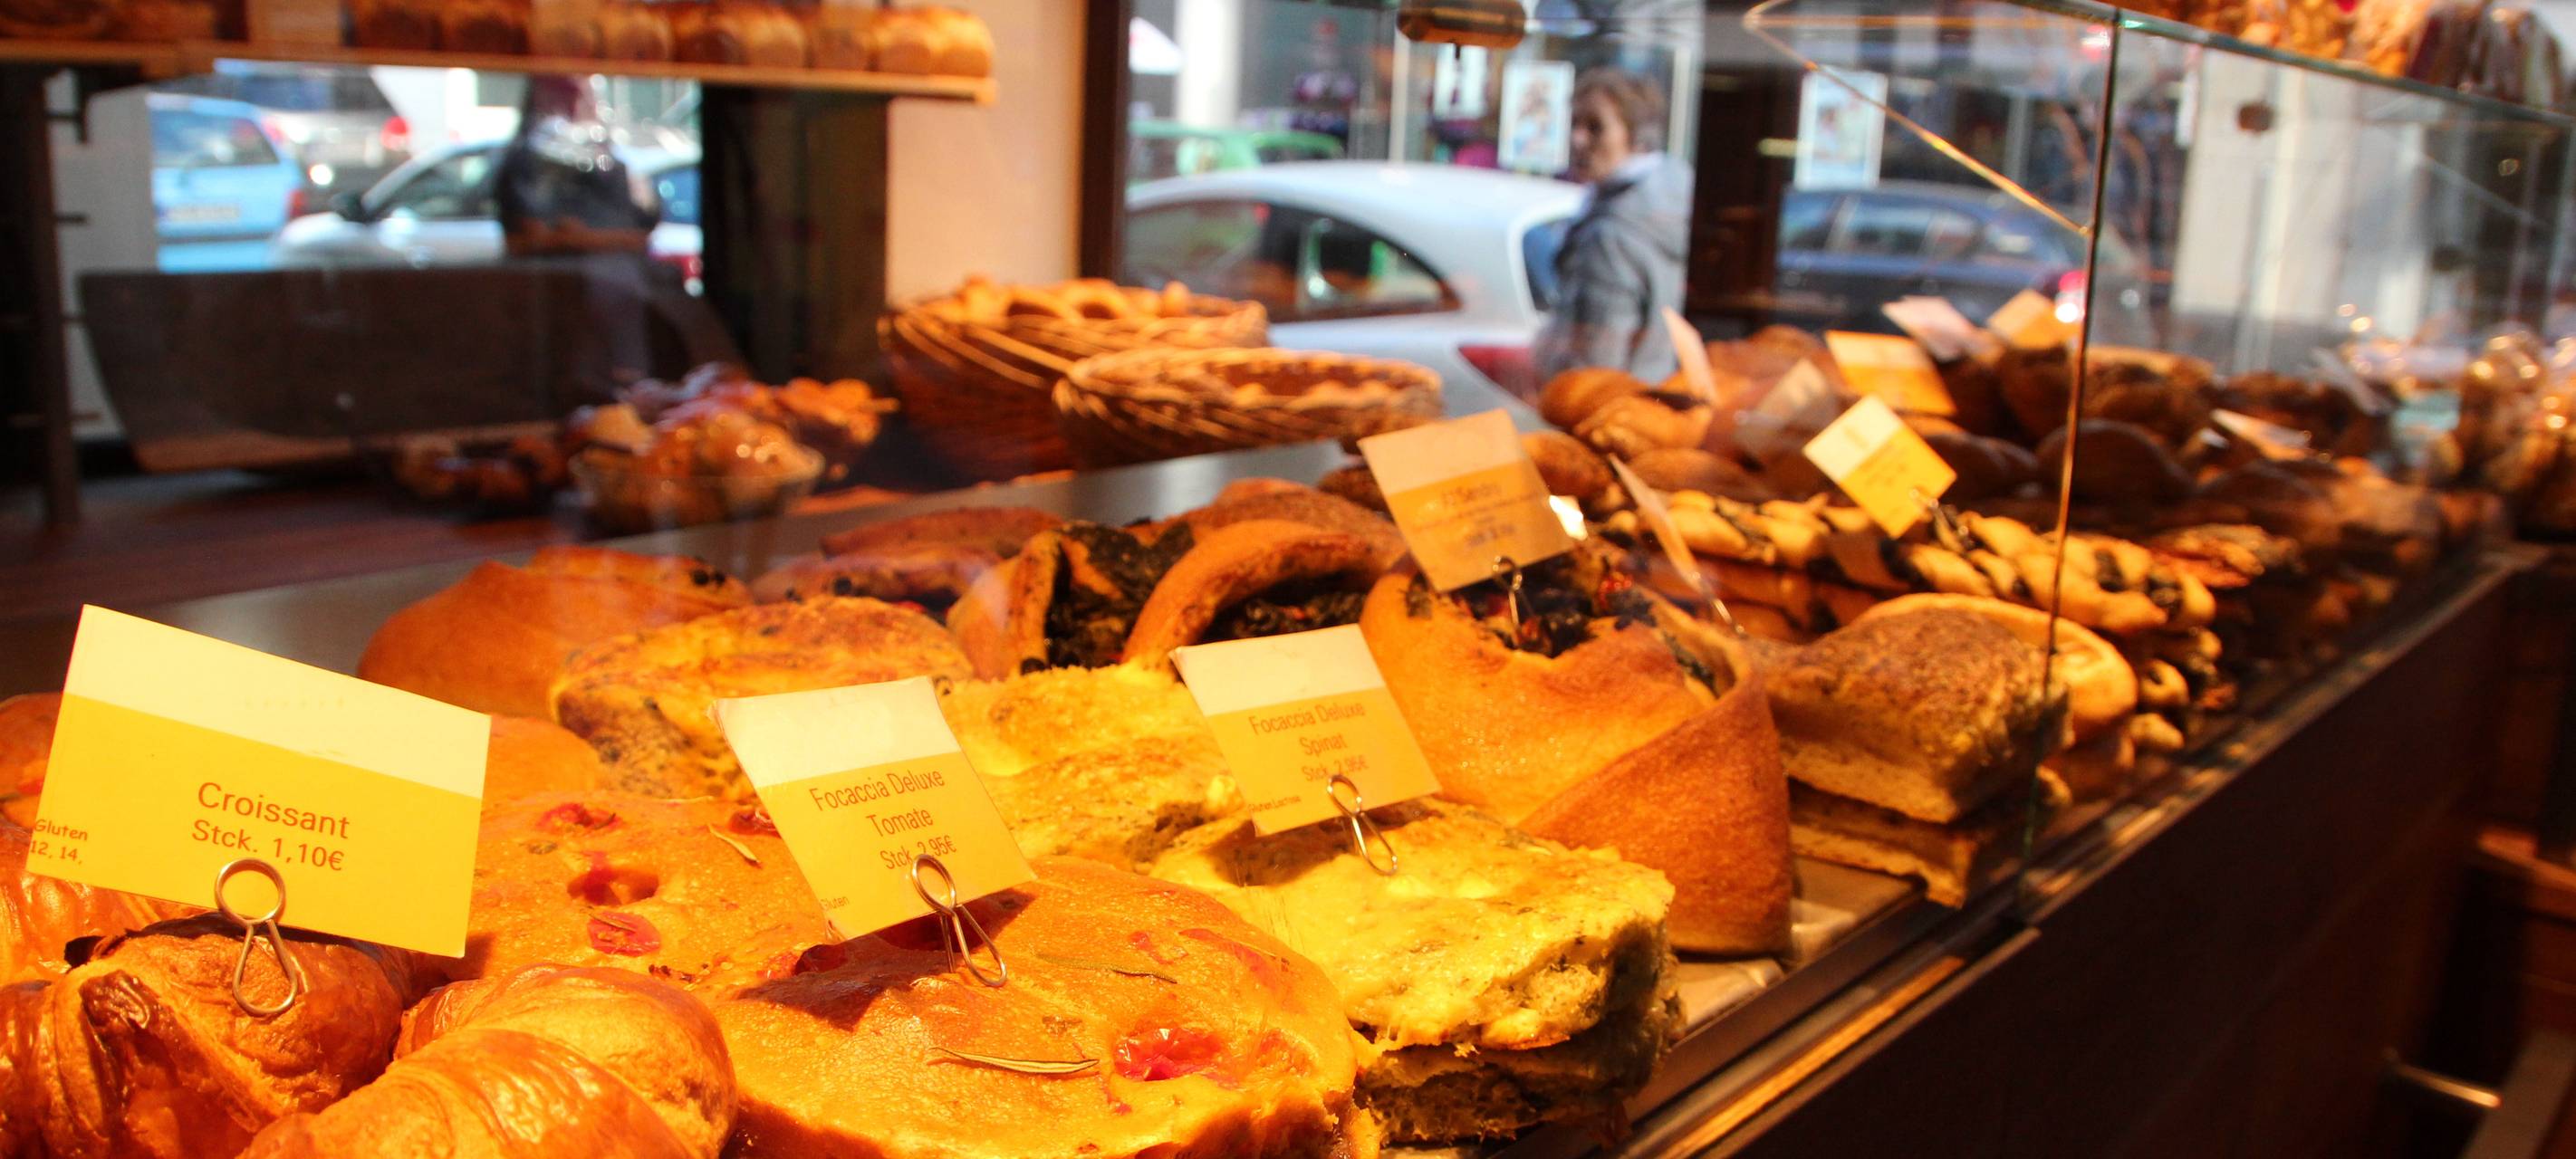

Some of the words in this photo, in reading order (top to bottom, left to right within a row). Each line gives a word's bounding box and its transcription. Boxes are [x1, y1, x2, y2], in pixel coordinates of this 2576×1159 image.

[1248, 706, 1316, 736] Focaccia
[1314, 702, 1367, 723] Deluxe
[1299, 733, 1349, 758] Spinat
[809, 775, 889, 812] Focaccia
[887, 769, 946, 796] Deluxe
[197, 781, 351, 840] Croissant
[866, 807, 934, 838] Tomate
[34, 819, 88, 841] Gluten
[192, 819, 259, 855] Stck.
[273, 837, 345, 873] 1,10€
